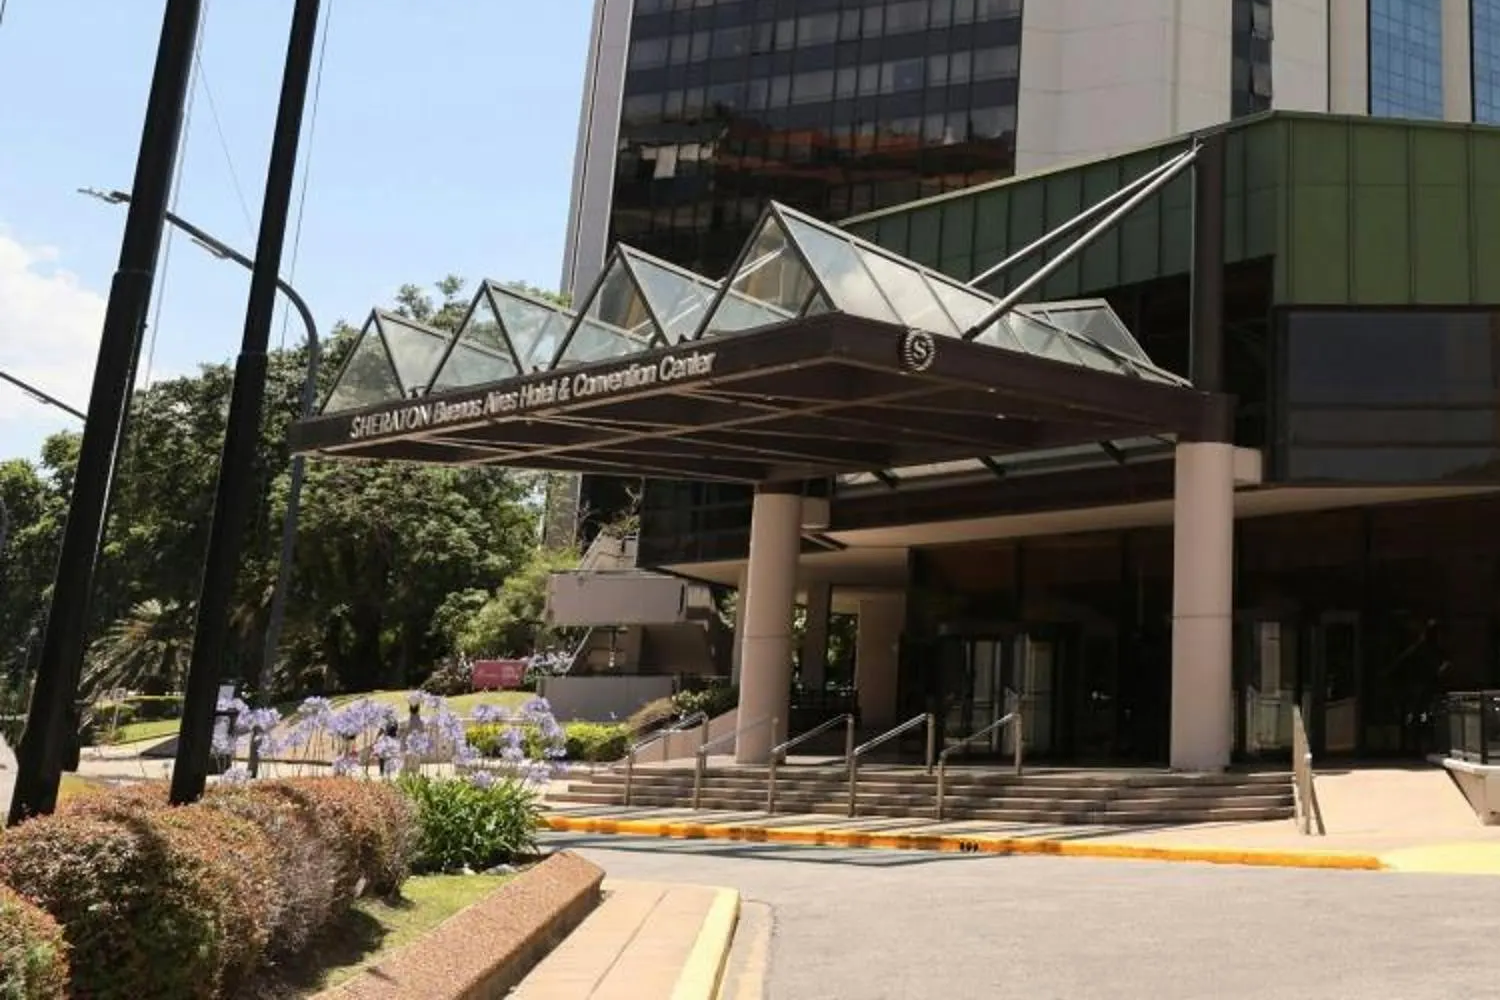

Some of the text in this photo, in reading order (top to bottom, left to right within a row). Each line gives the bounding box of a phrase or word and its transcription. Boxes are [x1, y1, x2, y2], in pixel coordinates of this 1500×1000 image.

[351, 351, 716, 439] SHERATON Buenos Aires Hotel & Convention Center
